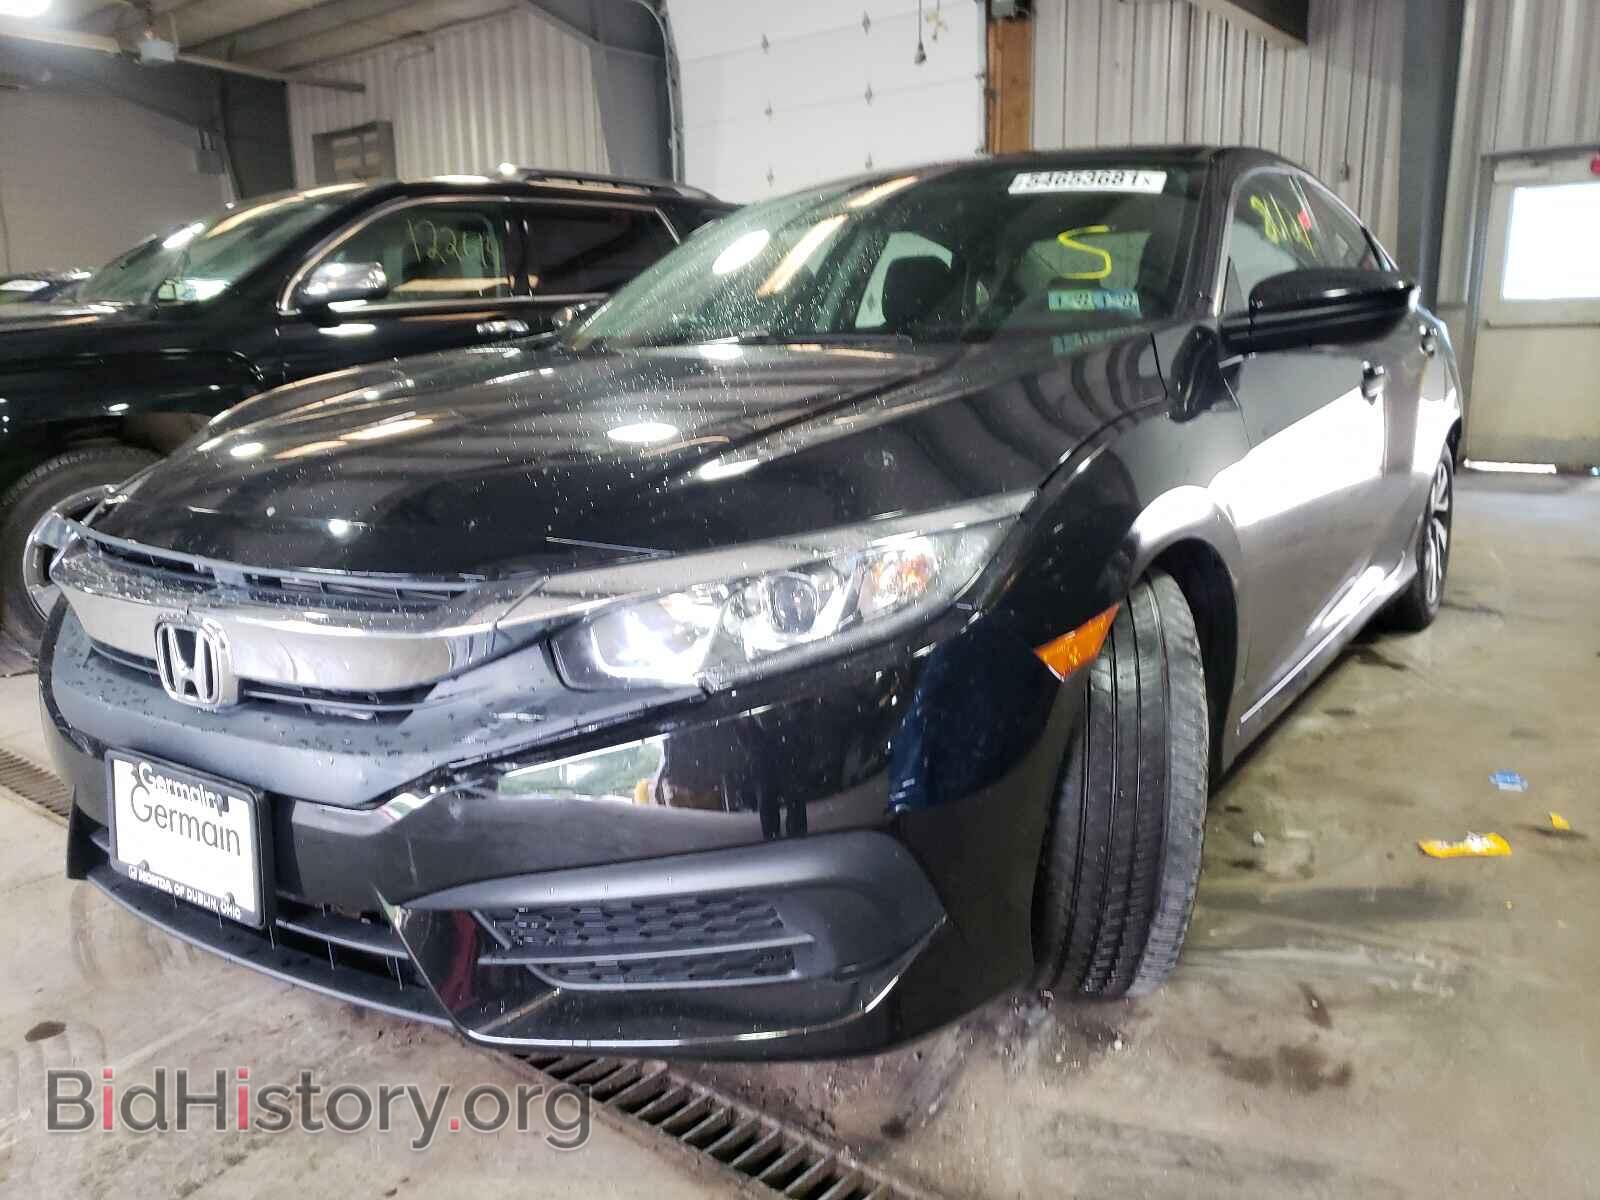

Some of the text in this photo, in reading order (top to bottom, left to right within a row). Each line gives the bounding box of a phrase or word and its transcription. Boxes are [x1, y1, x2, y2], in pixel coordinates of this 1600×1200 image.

[1058, 225, 1112, 280] S
[131, 784, 241, 857] Germain
[138, 869, 173, 894] HONDA
[174, 883, 185, 897] OF
[220, 900, 241, 920] OHIO
